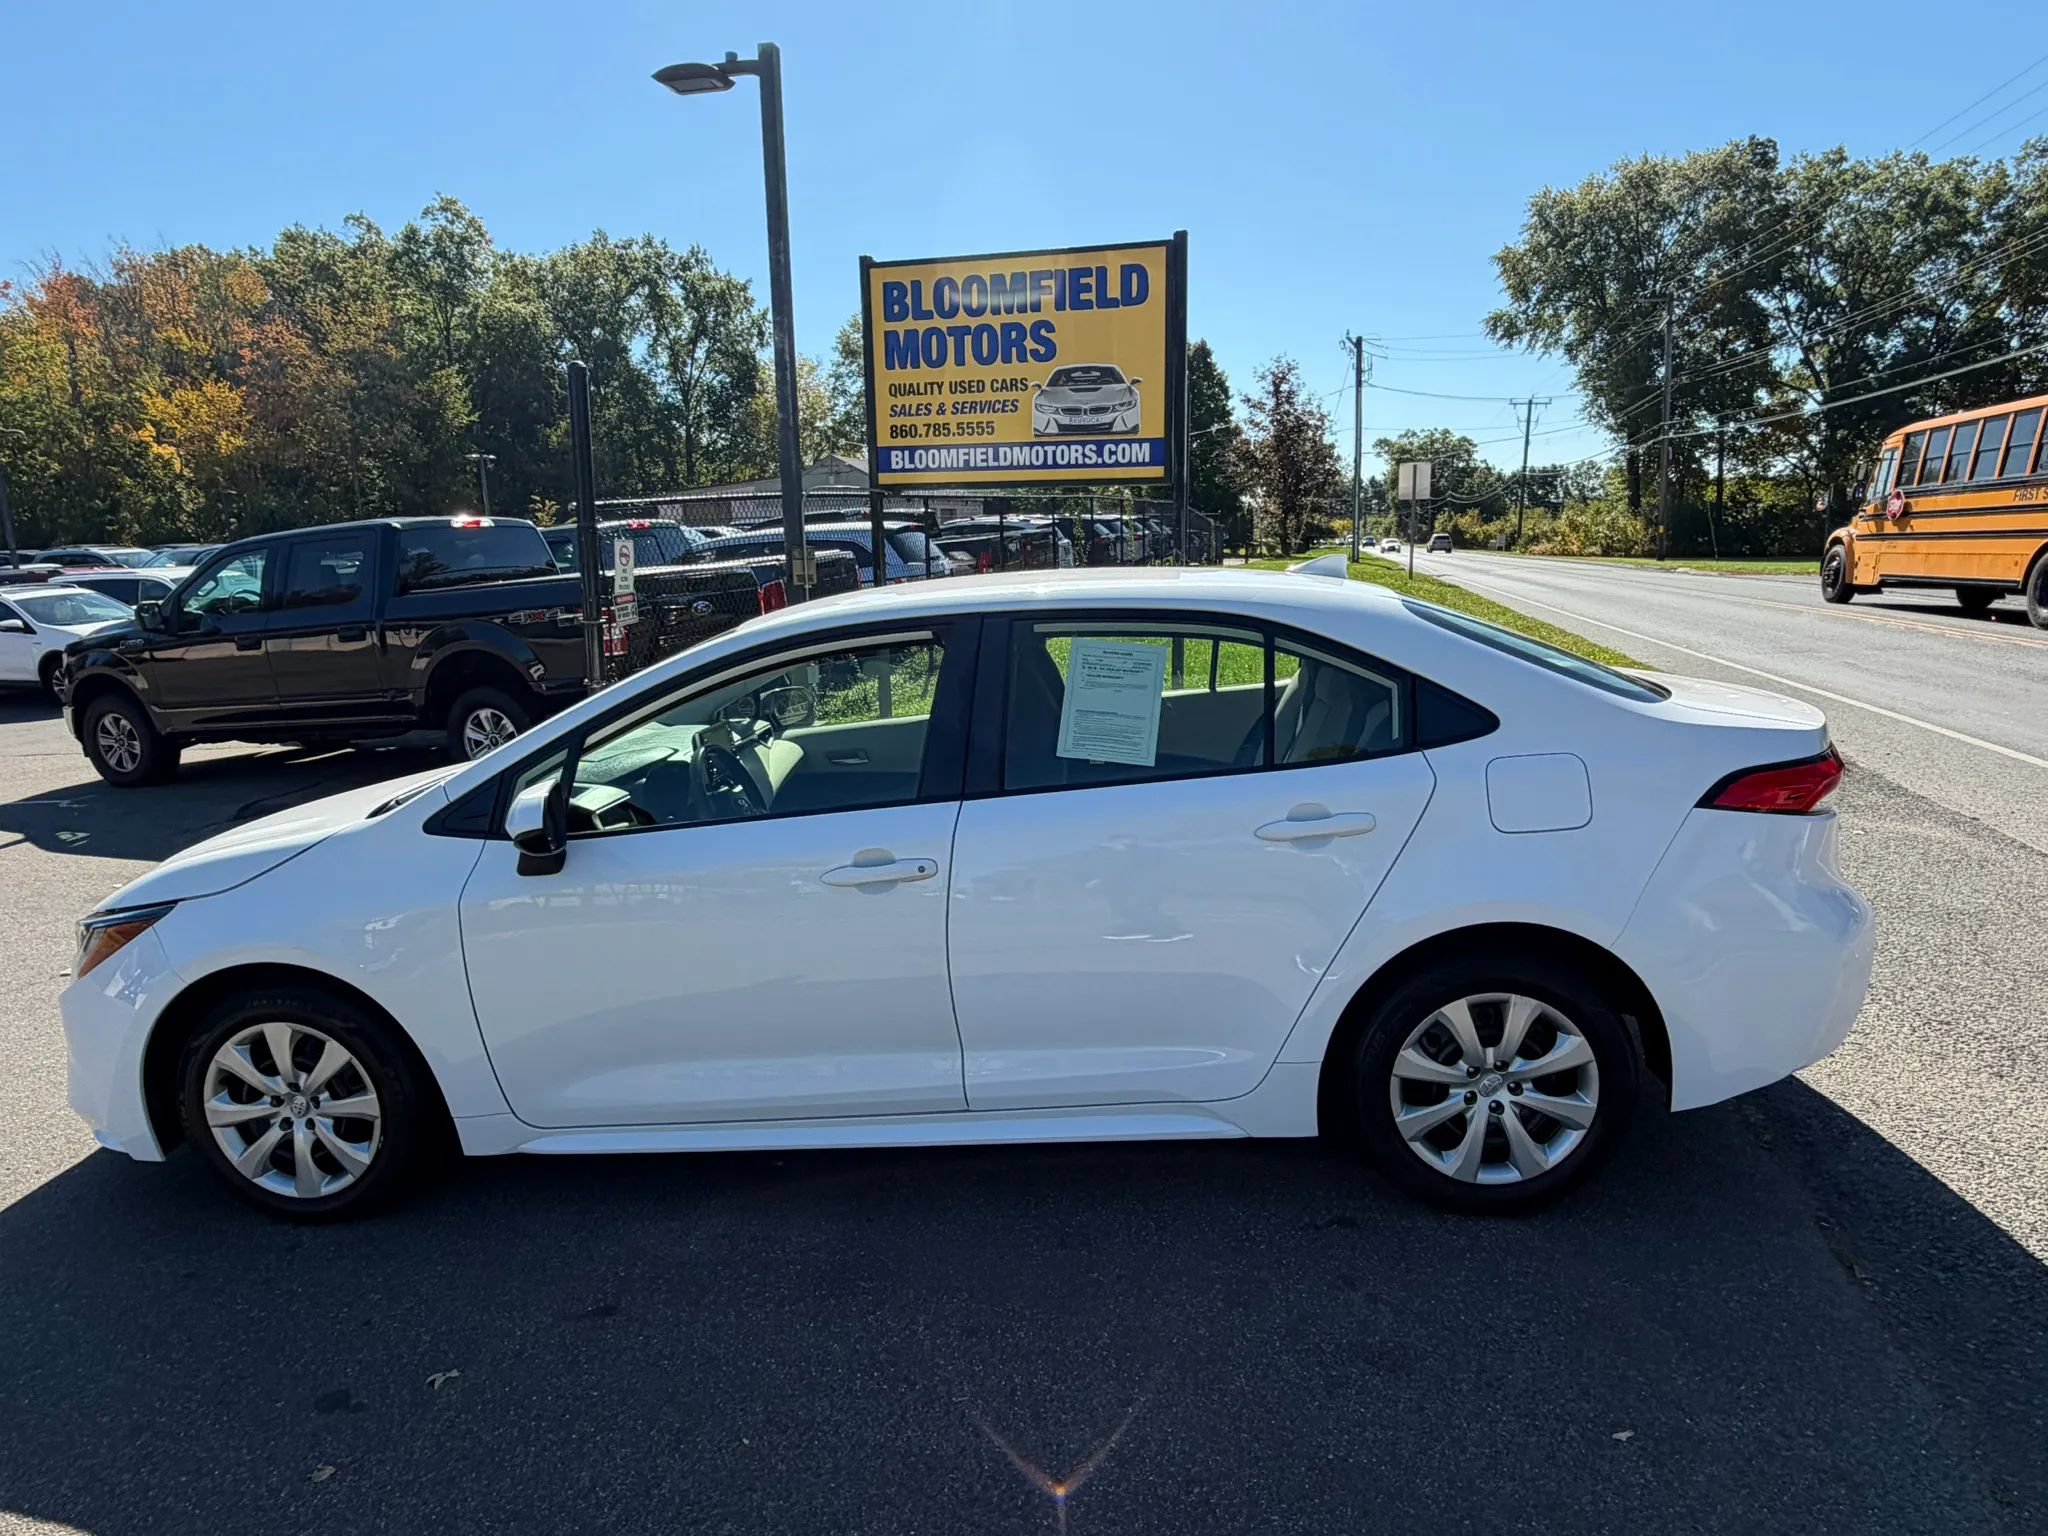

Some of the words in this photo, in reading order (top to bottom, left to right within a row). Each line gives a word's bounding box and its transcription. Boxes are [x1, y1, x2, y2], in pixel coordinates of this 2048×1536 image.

[882, 264, 1150, 322] BLOOMFIELD
[884, 320, 1057, 370] MOTORS
[888, 381, 944, 398] QUALITY
[949, 379, 985, 395] USED
[991, 377, 1029, 393] CARS
[889, 402, 932, 418] SALES
[936, 402, 947, 416] &
[950, 399, 1019, 415] SERVICES
[889, 421, 995, 439] 860.785.5555
[890, 443, 1150, 469] BLOOMFIELDMOTORS.COM
[2013, 487, 2040, 502] FIRST
